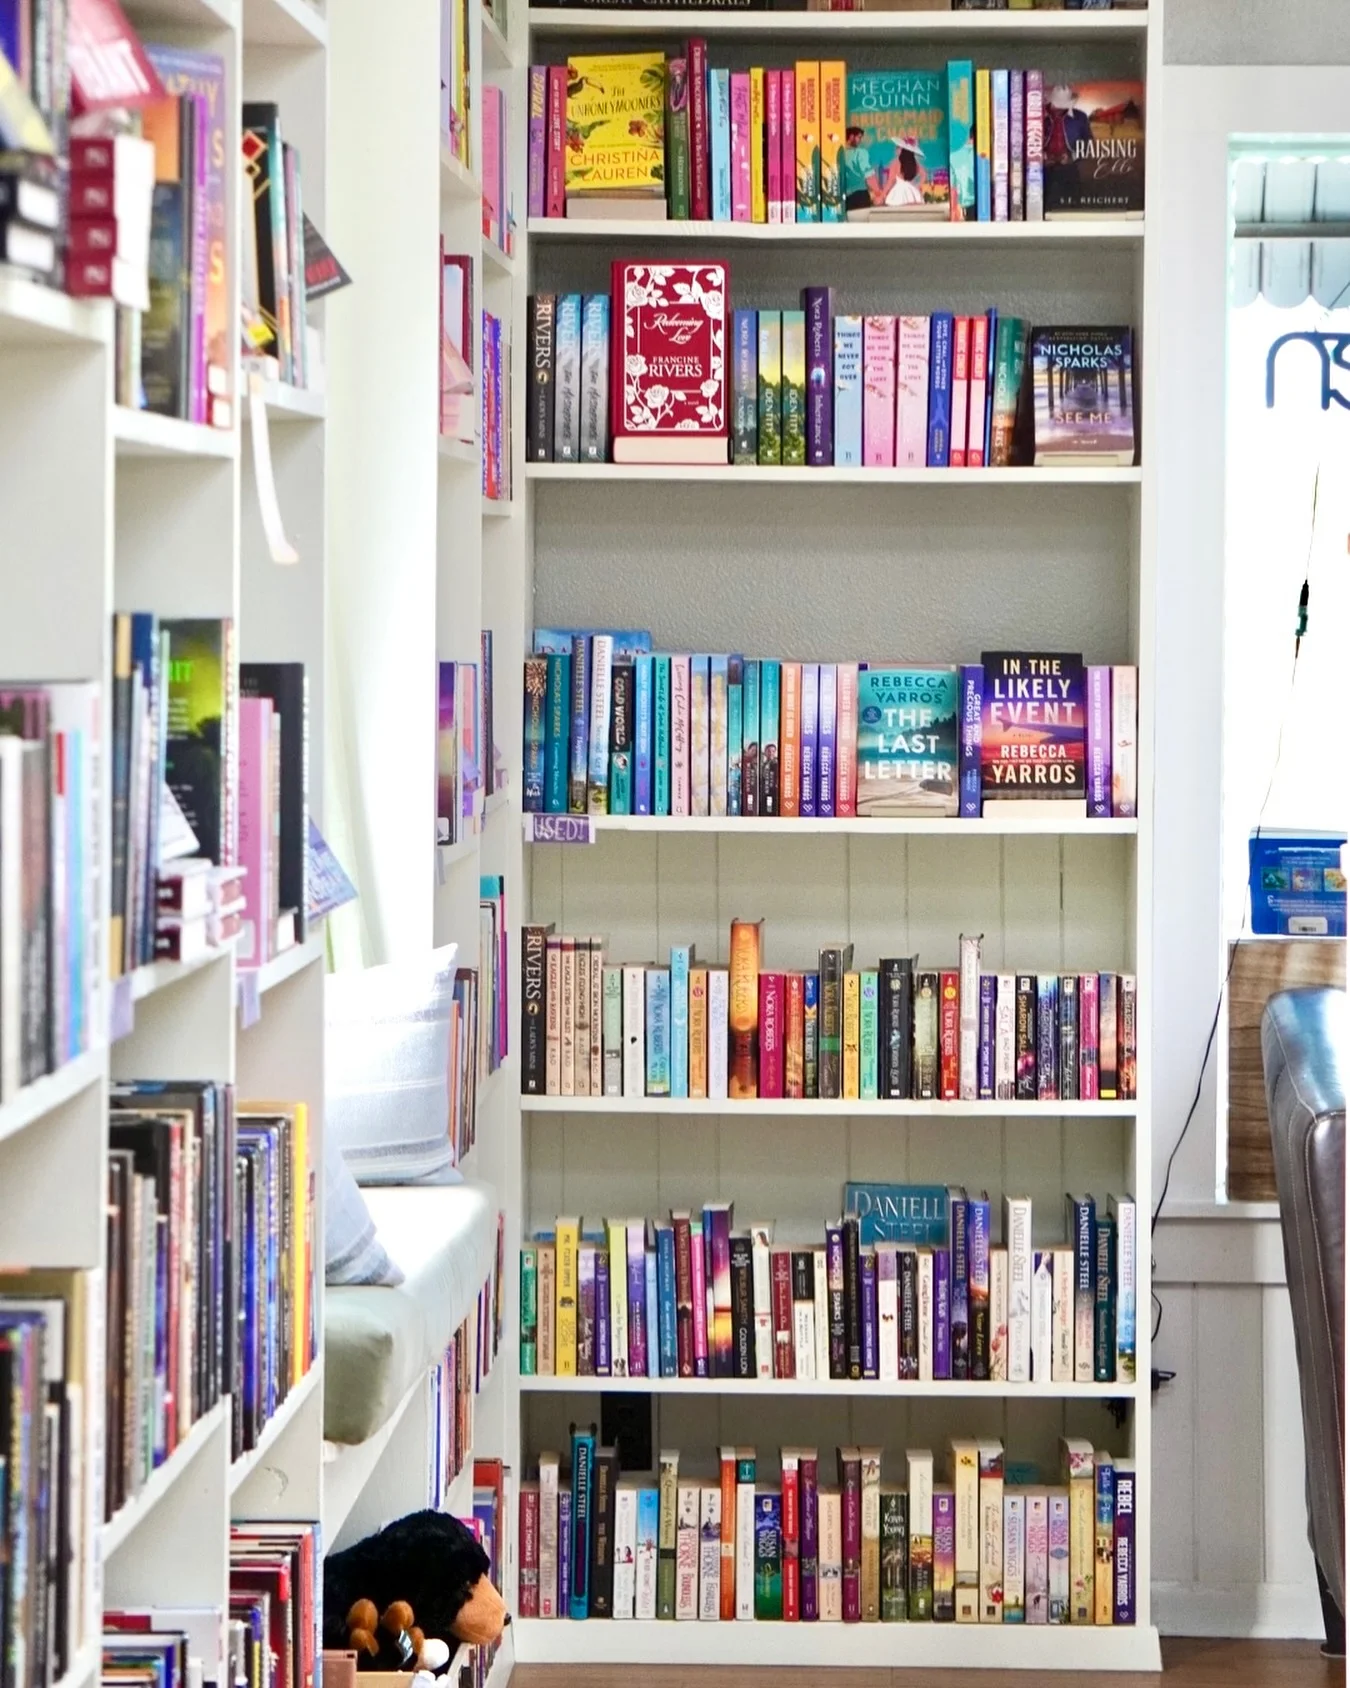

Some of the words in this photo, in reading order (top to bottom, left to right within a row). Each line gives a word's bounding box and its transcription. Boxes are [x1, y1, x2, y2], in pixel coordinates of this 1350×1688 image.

[694, 47, 702, 76] DEBBIE
[531, 72, 545, 119] SPIRAL
[694, 76, 702, 122] MACOMBER
[853, 79, 940, 96] MEGHAN
[862, 95, 931, 110] QUINN
[850, 112, 944, 128] BRIDESMAID
[570, 149, 660, 167] CHRISTINA
[1076, 139, 1136, 159] RAISING
[581, 165, 648, 182] LAUREN
[812, 297, 823, 320] Nora
[536, 304, 552, 368] RIVERS
[561, 302, 576, 357] RIVERS
[588, 302, 602, 357] RIVERS
[643, 313, 704, 335] Redeeming
[669, 325, 698, 344] Love
[812, 322, 823, 357] Roberts
[1040, 344, 1122, 356] NICHOLAS
[648, 364, 704, 378] RIVERS
[1056, 356, 1108, 368] SPARKS
[997, 362, 1006, 410] NICHOLAS
[790, 388, 798, 434] IDENTITY
[814, 394, 823, 445] Inheritance
[1056, 412, 1084, 424] SEE
[1090, 412, 1113, 424] ME
[994, 414, 1005, 448] SPARKS
[576, 640, 584, 686] DANIELLE
[595, 640, 606, 695] DANIELLE
[1003, 659, 1020, 675] IN
[1028, 659, 1061, 676] THE
[553, 658, 562, 704] NICHOLAS
[615, 677, 625, 704] COLD
[870, 676, 948, 690] REBECCA
[994, 678, 1071, 698] LIKELY
[576, 688, 584, 714] STEEL
[595, 696, 606, 720] STEEL
[876, 691, 943, 705] YARROS
[966, 680, 974, 724] PRECIOUS
[531, 696, 539, 739] NICHOLAS
[553, 706, 562, 738] SPARKS
[615, 706, 625, 745] WORLD
[884, 708, 933, 727] THE
[990, 702, 1076, 725] EVENT
[878, 734, 940, 754] LAST
[966, 724, 974, 757] THINGS
[1000, 744, 1067, 758] REBECCA
[531, 742, 539, 769] SPARKS
[864, 760, 952, 780] LETTER
[992, 764, 1076, 784] YARROS
[525, 935, 542, 999] RIVERS
[765, 990, 776, 1016] NORA
[1018, 995, 1027, 1032] SHARON
[765, 1018, 776, 1052] ROBERTS
[1018, 1034, 1027, 1056] SALA
[956, 1205, 965, 1251] DANIELLE
[975, 1208, 984, 1256] DANIELLE
[1012, 1207, 1026, 1252] DANIELLE
[1080, 1206, 1089, 1258] DANIELLE
[1124, 1207, 1132, 1256] DANIELLE
[1096, 1228, 1110, 1272] DANIELLE
[832, 1246, 841, 1290] NICHOLAS
[956, 1254, 965, 1280] STEEL
[1012, 1254, 1026, 1282] STEEL
[1080, 1260, 1089, 1290] STEEL
[1124, 1258, 1132, 1286] STEEL
[1096, 1274, 1110, 1302] STEEL
[832, 1292, 841, 1320] SPARKS
[738, 1328, 747, 1356] GOLDEN
[740, 1356, 748, 1374] LION
[578, 1448, 587, 1490] DANIELLE
[578, 1494, 587, 1519] STEEL
[1118, 1480, 1132, 1516] REBEL
[884, 1512, 904, 1524] Karen
[1008, 1516, 1016, 1545] SUSAN
[681, 1532, 692, 1568] THORNE
[758, 1530, 767, 1558] WIGGS
[767, 1530, 776, 1558] SUSAN
[944, 1526, 952, 1552] SUSAN
[1028, 1525, 1037, 1554] WIGGS
[1038, 1524, 1046, 1554] SUSAN
[702, 1546, 714, 1580] THORNE
[1008, 1547, 1016, 1576] WIGGS
[1118, 1537, 1128, 1572] REBECCA
[704, 1582, 717, 1613] FEARLESS
[1118, 1574, 1128, 1606] YARROS
